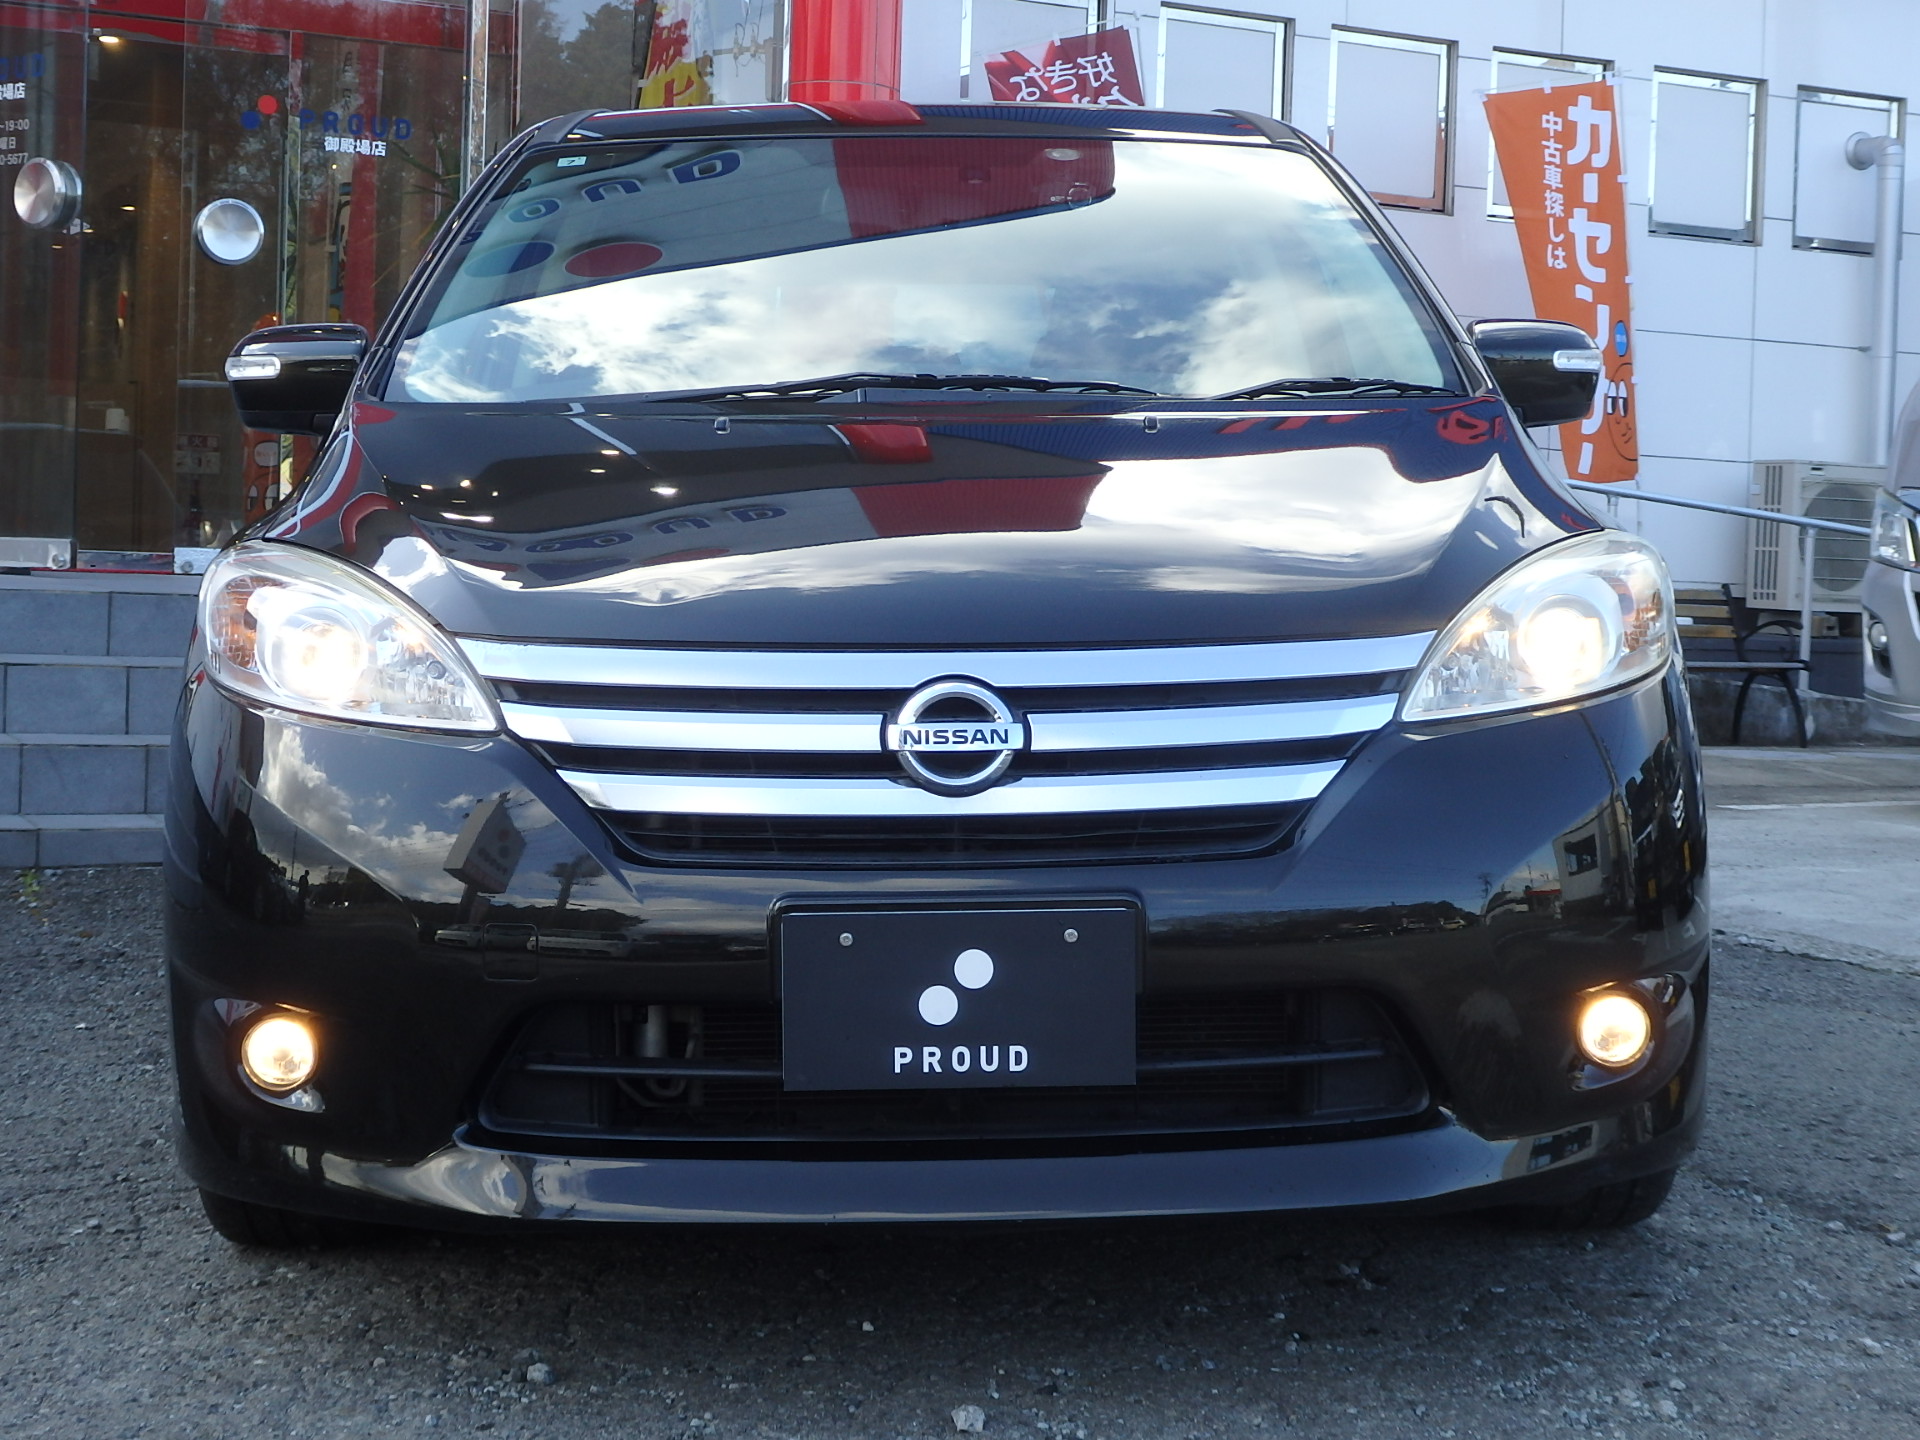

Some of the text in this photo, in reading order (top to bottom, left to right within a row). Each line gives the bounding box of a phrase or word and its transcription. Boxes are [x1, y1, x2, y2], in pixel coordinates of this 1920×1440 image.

[0, 82, 26, 100] 場店
[300, 108, 412, 140] PROUD
[324, 136, 387, 157] 御殿場店
[1541, 111, 1567, 270] 中古車探しは
[903, 728, 1010, 747] NISSAN
[893, 1044, 1029, 1074] PROUD
